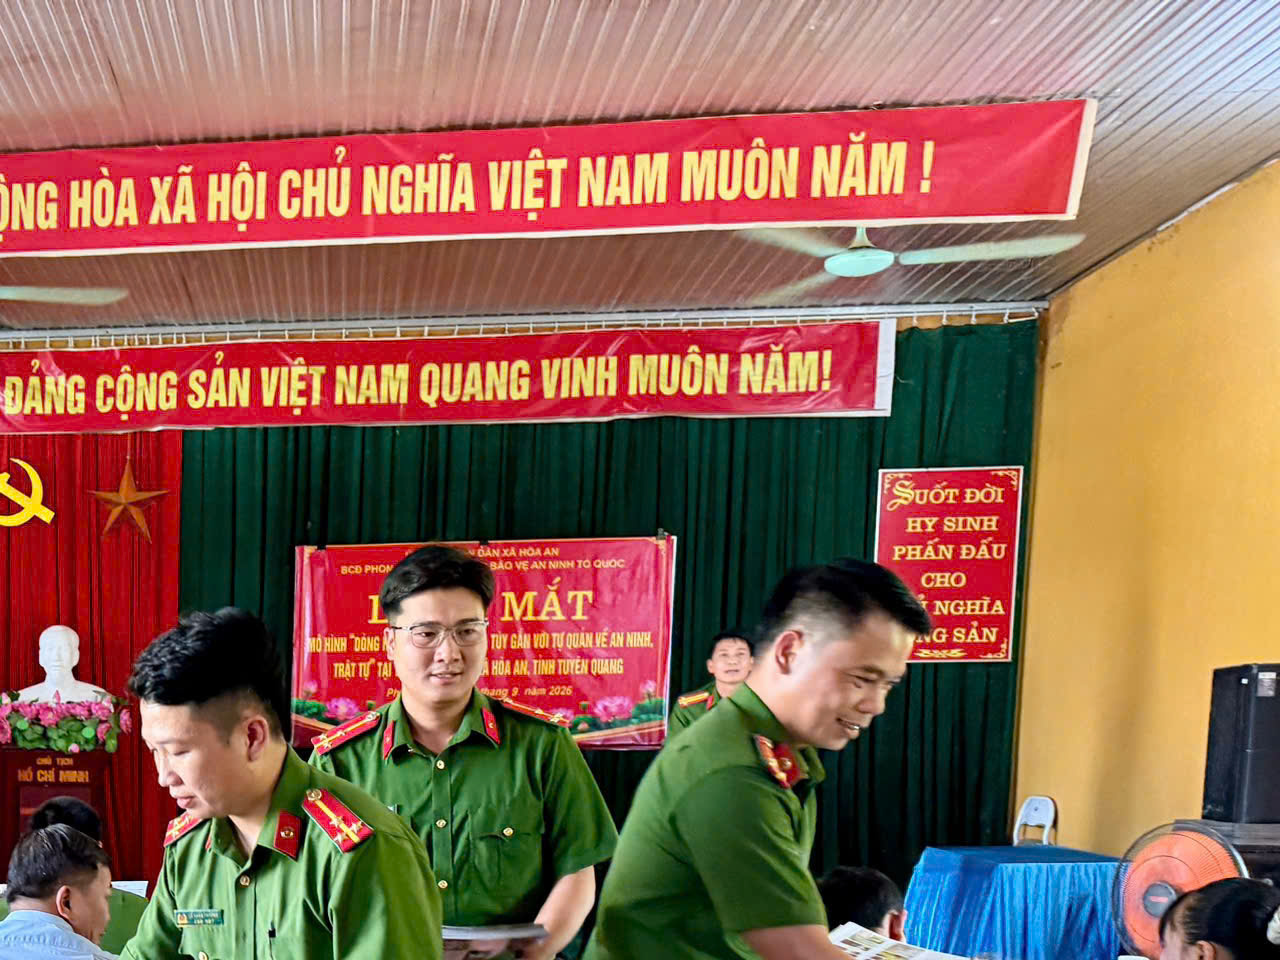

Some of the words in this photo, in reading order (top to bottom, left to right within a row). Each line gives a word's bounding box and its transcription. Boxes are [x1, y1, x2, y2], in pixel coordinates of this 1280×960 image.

[70, 168, 138, 228] HÒA
[149, 166, 196, 224] XÃ
[208, 162, 266, 231] HỘI
[279, 146, 350, 218] CHỦ
[363, 154, 475, 215] NGHĨA
[488, 149, 567, 220] VIỆT
[578, 152, 669, 207] NAM
[681, 138, 799, 201] MUÔN
[811, 132, 907, 197] NĂM
[920, 141, 934, 193] !
[4, 360, 85, 415] ĐẢNG
[97, 360, 177, 420] CỘNG
[187, 352, 251, 409] SẢN
[260, 358, 325, 415] VIỆT
[335, 364, 409, 405] NAM
[418, 358, 531, 408] QUANG
[540, 354, 617, 401] VINH
[628, 345, 728, 396] MUÔN
[739, 343, 832, 394] NĂM!
[887, 480, 959, 511] SUỐT
[964, 483, 1005, 503] ĐỜI
[905, 517, 939, 532] HY
[943, 516, 999, 531] SINH
[543, 547, 559, 557] AN
[892, 538, 955, 560] PHẤN
[960, 537, 1007, 559] ĐẤU
[364, 564, 394, 574] PHON
[530, 561, 546, 569] AN
[548, 560, 575, 569] NINH
[921, 572, 966, 588] CHO
[501, 577, 593, 621] MẮT
[933, 597, 1005, 615] NGHĨA
[609, 632, 624, 648] AN
[952, 621, 999, 643] SẢN
[590, 658, 623, 677] QUANG
